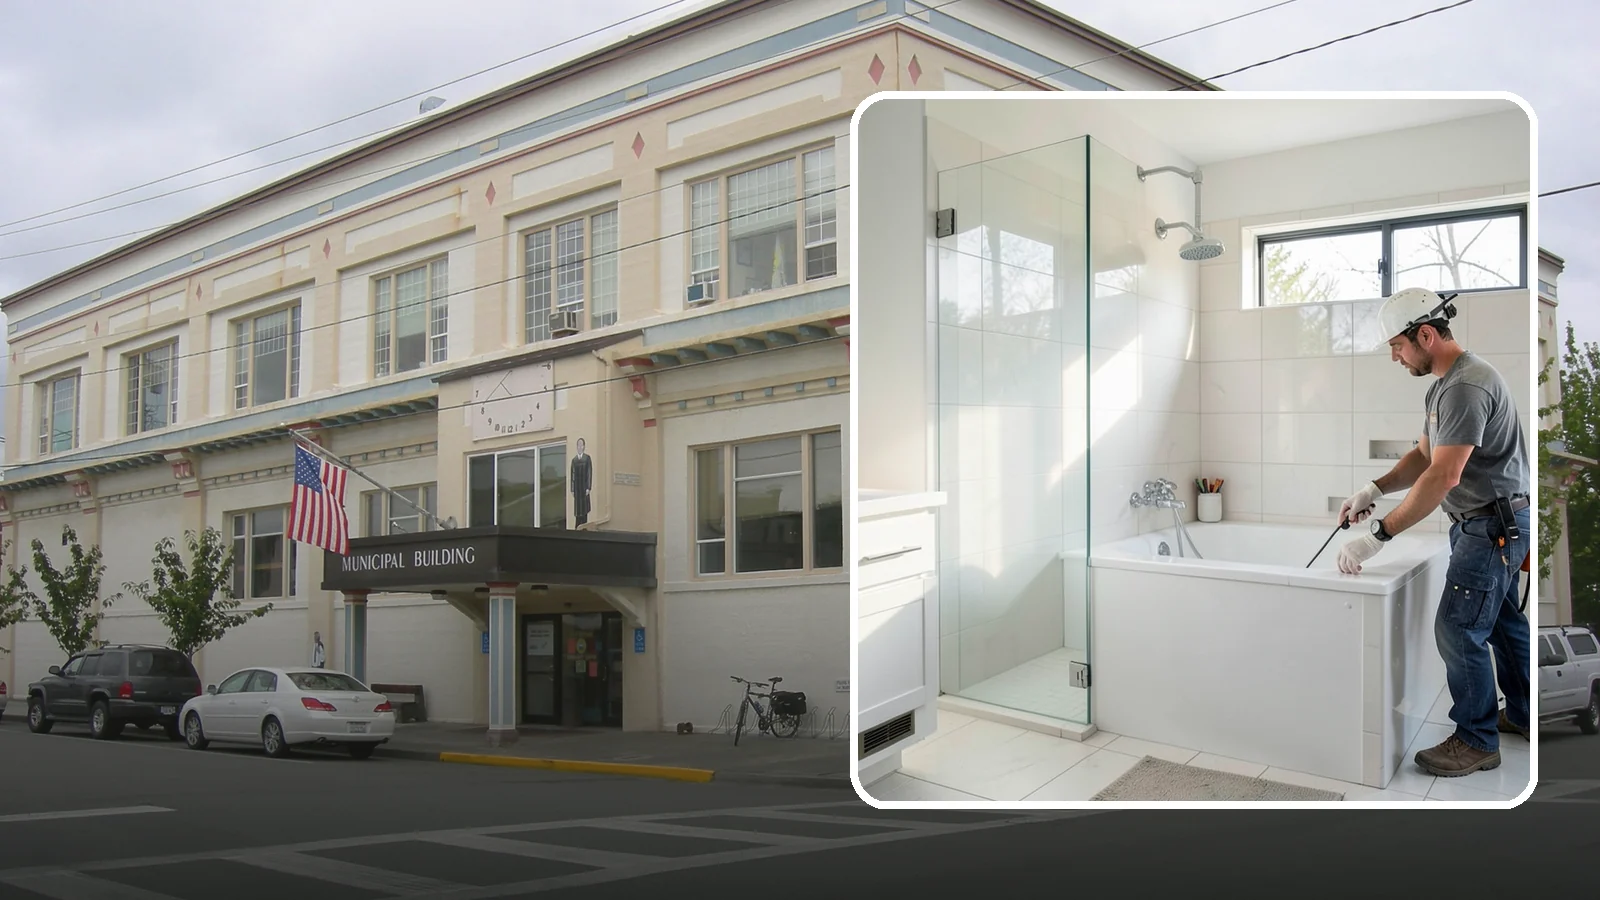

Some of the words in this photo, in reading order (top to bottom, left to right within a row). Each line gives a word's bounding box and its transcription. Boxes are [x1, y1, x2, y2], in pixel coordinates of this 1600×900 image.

[546, 362, 552, 371] 6
[475, 390, 479, 398] 7
[536, 402, 540, 410] 4
[480, 407, 485, 415] 8
[487, 417, 492, 426] 9
[528, 414, 533, 422] 3
[494, 423, 500, 432] 10
[507, 425, 514, 433] 12
[520, 420, 526, 429] 2
[501, 425, 506, 434] 11
[342, 552, 405, 572] MUNICIPAL
[414, 546, 475, 567] BUILDING
